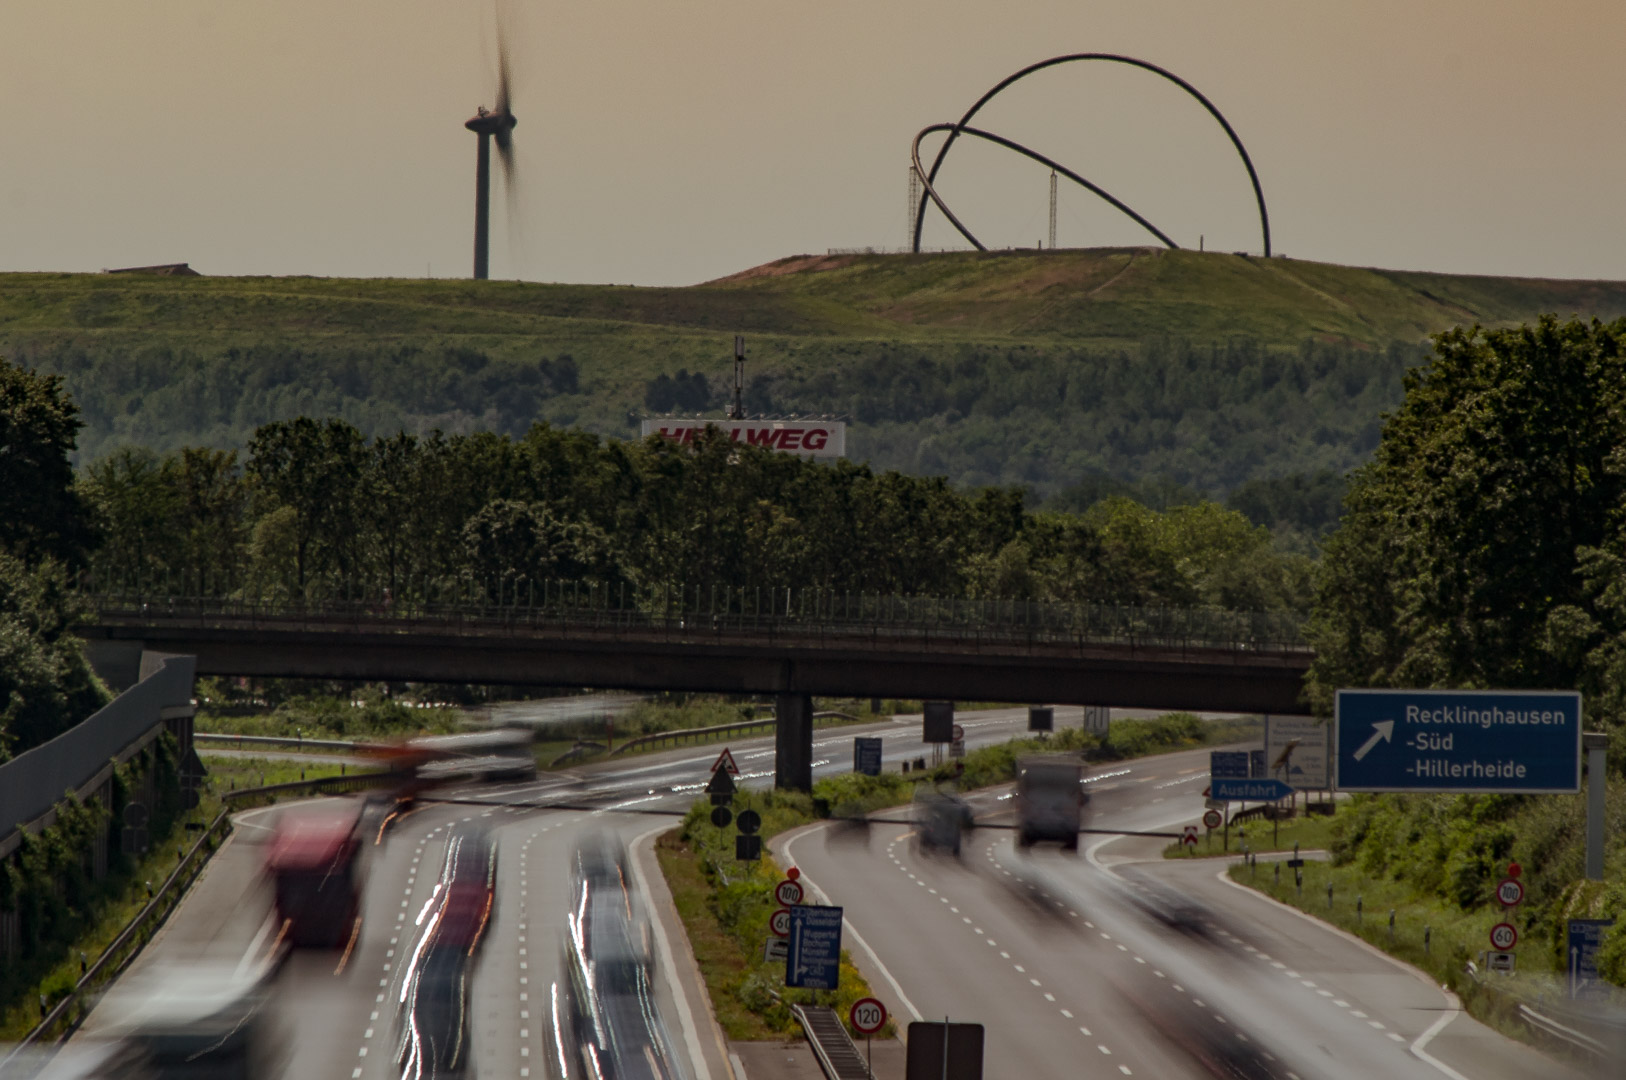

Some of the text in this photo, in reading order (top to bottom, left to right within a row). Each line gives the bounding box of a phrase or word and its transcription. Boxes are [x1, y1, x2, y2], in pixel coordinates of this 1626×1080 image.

[1406, 705, 1565, 729] Recklinghausen
[1406, 732, 1453, 751] -Süd
[1406, 759, 1527, 778] -Hillerheide
[1219, 783, 1277, 797] Ausfahrt
[782, 887, 799, 901] 100
[1502, 886, 1518, 900] 100
[1496, 930, 1512, 943] 60
[857, 1009, 880, 1025] 120
